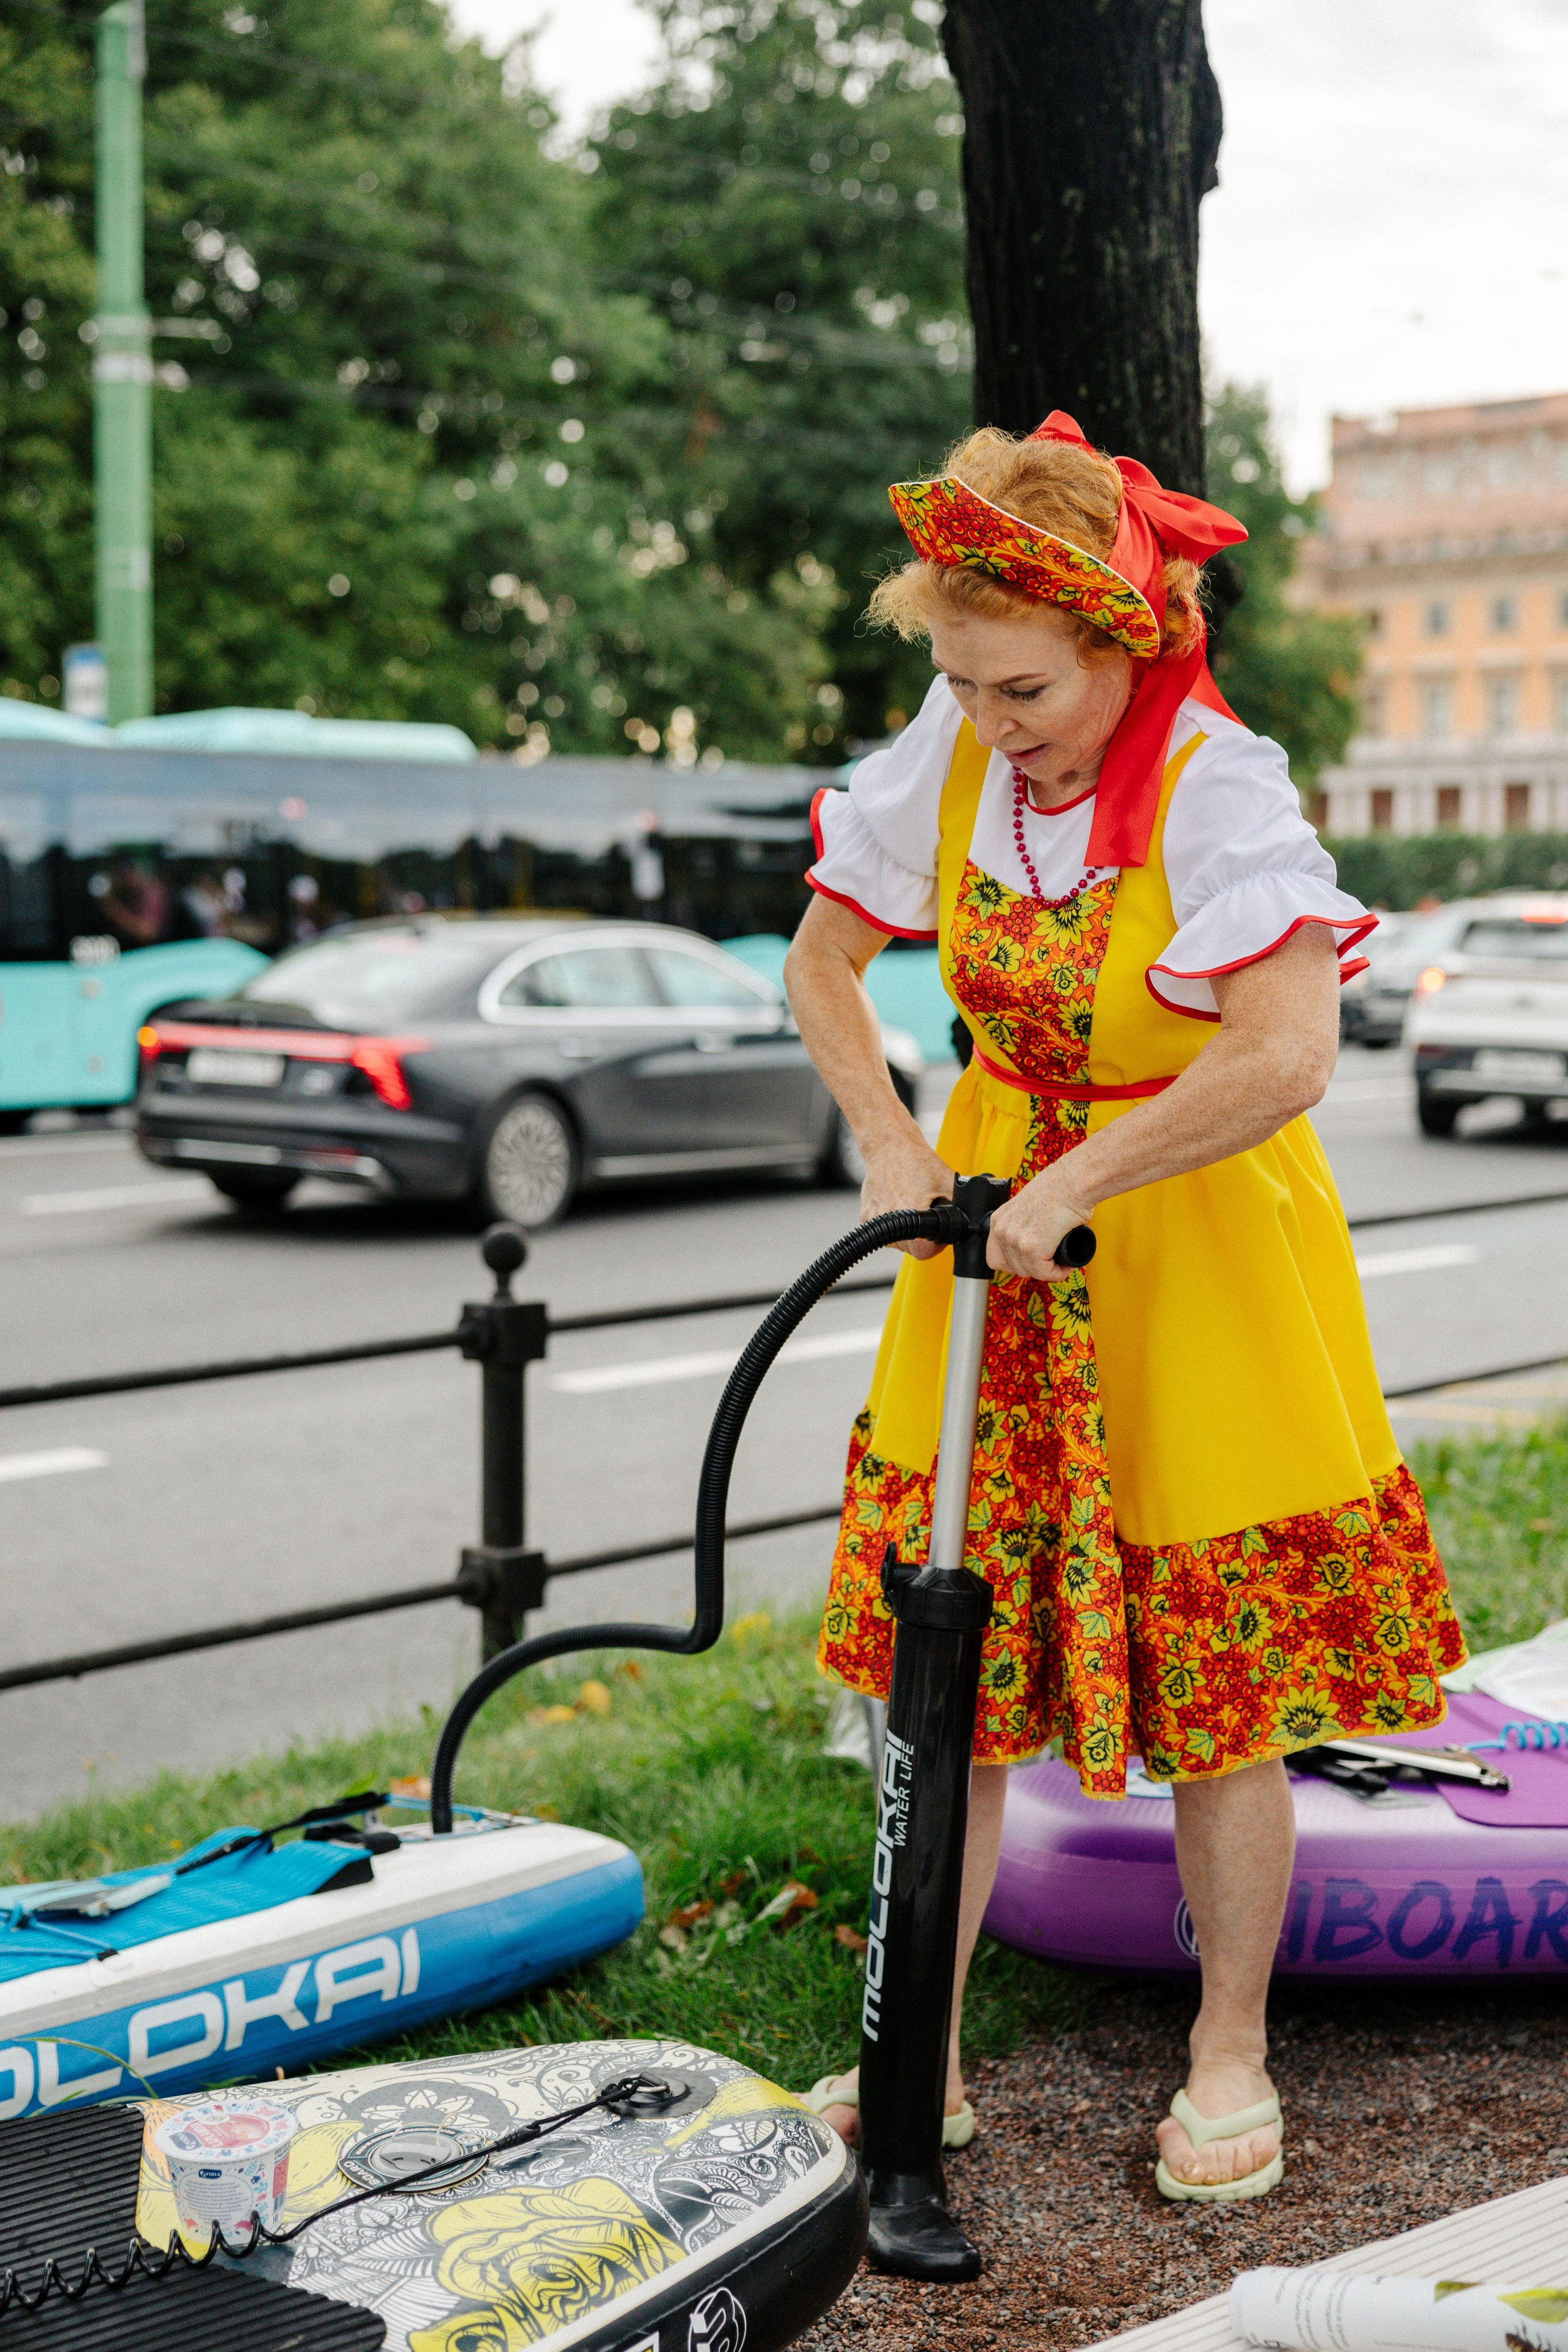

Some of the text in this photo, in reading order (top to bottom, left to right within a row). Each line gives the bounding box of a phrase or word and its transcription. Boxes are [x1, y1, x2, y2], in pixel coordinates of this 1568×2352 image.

[894, 1741, 914, 1846] WATER LIFE
[862, 1728, 903, 2042] MOLOKAI
[177, 2133, 190, 2146] VIOLA
